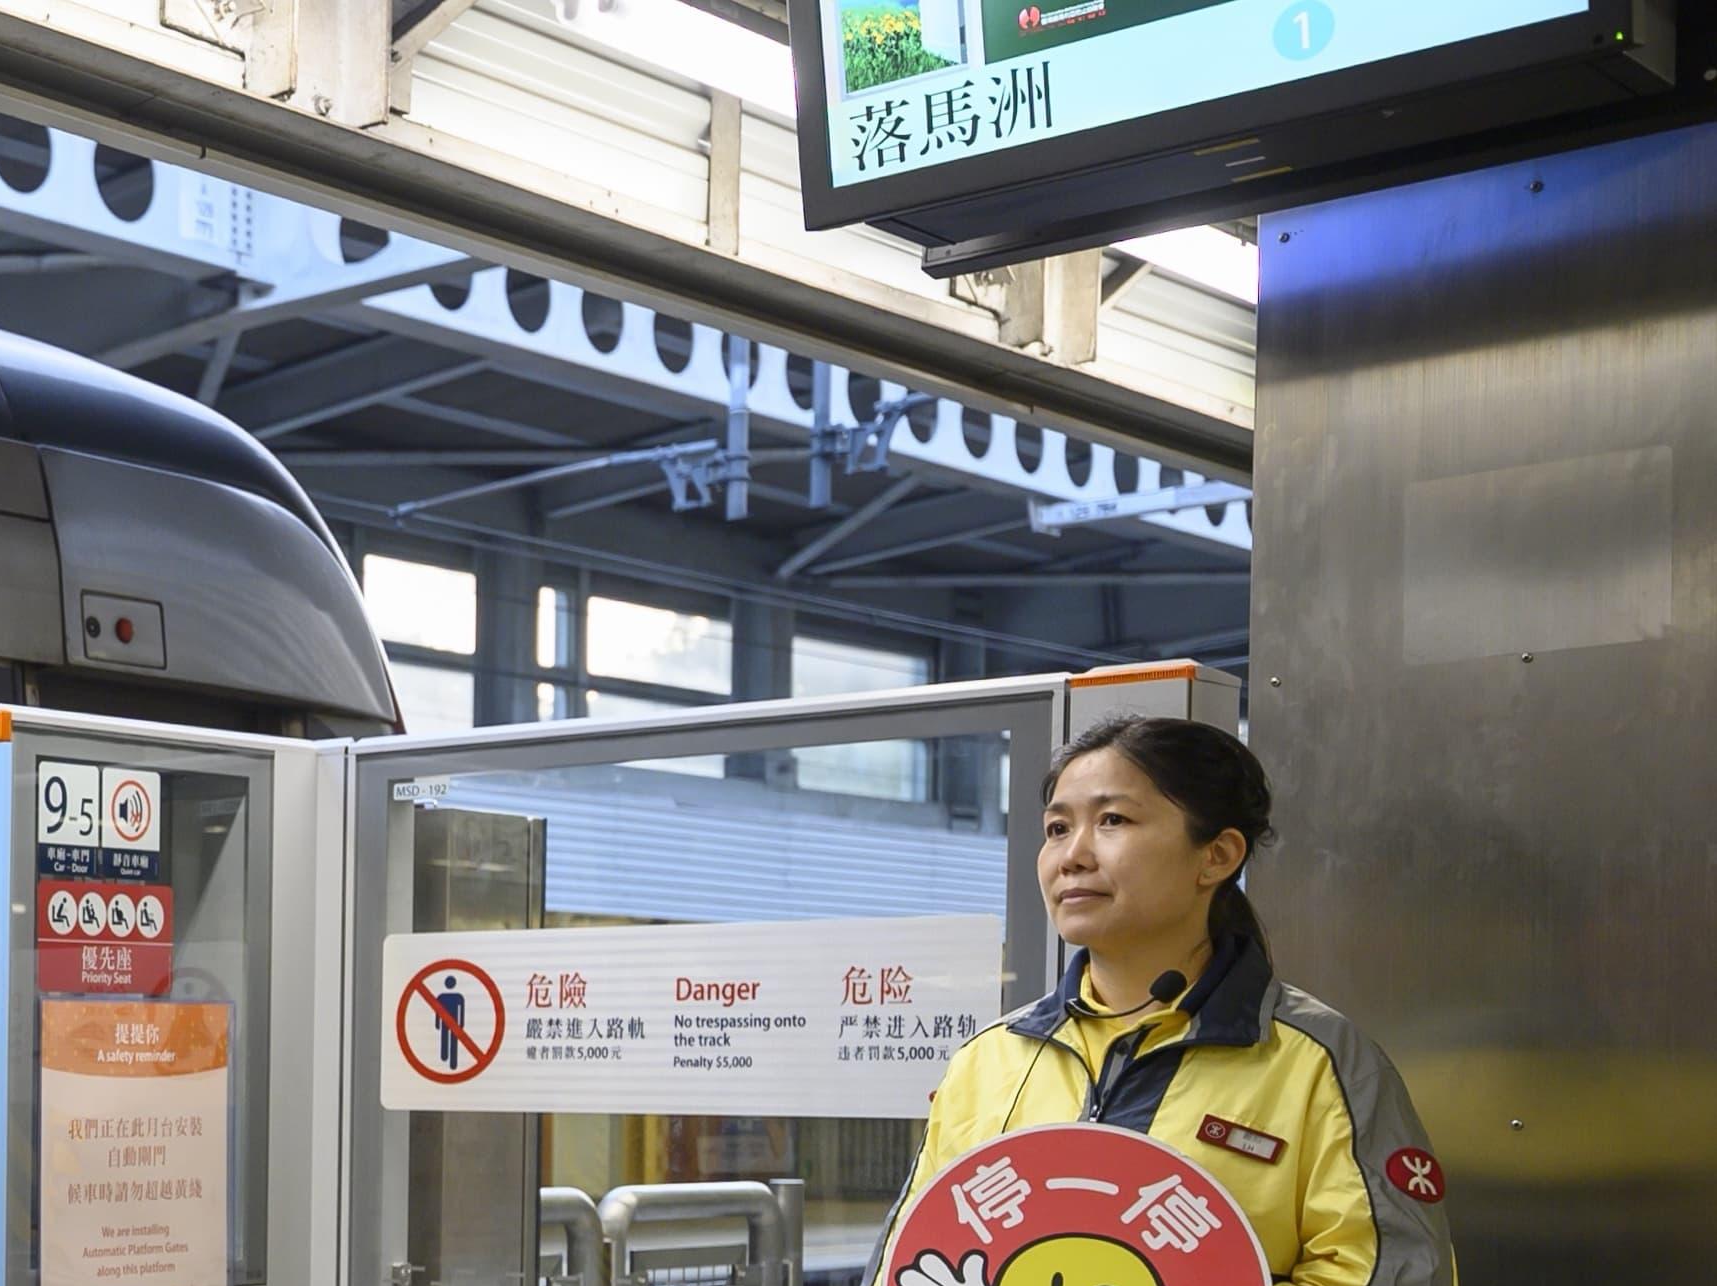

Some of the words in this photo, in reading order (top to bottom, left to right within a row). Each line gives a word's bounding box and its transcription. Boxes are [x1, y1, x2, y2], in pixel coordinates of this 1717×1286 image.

[1292, 10, 1310, 49] 1
[849, 61, 1053, 171] 落馬洲
[396, 784, 420, 798] MSD
[429, 783, 447, 796] 192
[82, 944, 132, 972] 優先座
[82, 971, 112, 986] Priority
[114, 972, 132, 985] Seat
[525, 971, 588, 1009] 危險
[841, 964, 915, 1006] 危险
[675, 976, 761, 1008] Danger
[114, 1023, 160, 1045] 提提你
[525, 1016, 646, 1040] 嚴禁進入路軌
[674, 1014, 693, 1029] No
[696, 1013, 771, 1032] trespassing
[774, 1013, 807, 1028] onto
[838, 1014, 977, 1040] 严禁进入路轨
[674, 1032, 696, 1047] the
[698, 1032, 731, 1048] track
[97, 1049, 105, 1062] A
[106, 1049, 133, 1065] safety
[136, 1049, 176, 1063] reminder
[673, 1055, 714, 1071] Penalty
[716, 1055, 753, 1069] $5,000
[68, 1116, 203, 1140] 我們正在此月台安裝
[108, 1145, 167, 1168] 自動閘門
[950, 1156, 1223, 1254] 停一停
[101, 1226, 115, 1238] We
[117, 1228, 130, 1237] are
[132, 1224, 170, 1238] installing
[82, 1246, 126, 1258] Automatic
[128, 1243, 164, 1256] Platform
[165, 1241, 189, 1253] Gates
[97, 1264, 121, 1279] along
[123, 1262, 138, 1275] this
[140, 1261, 176, 1277] platform
